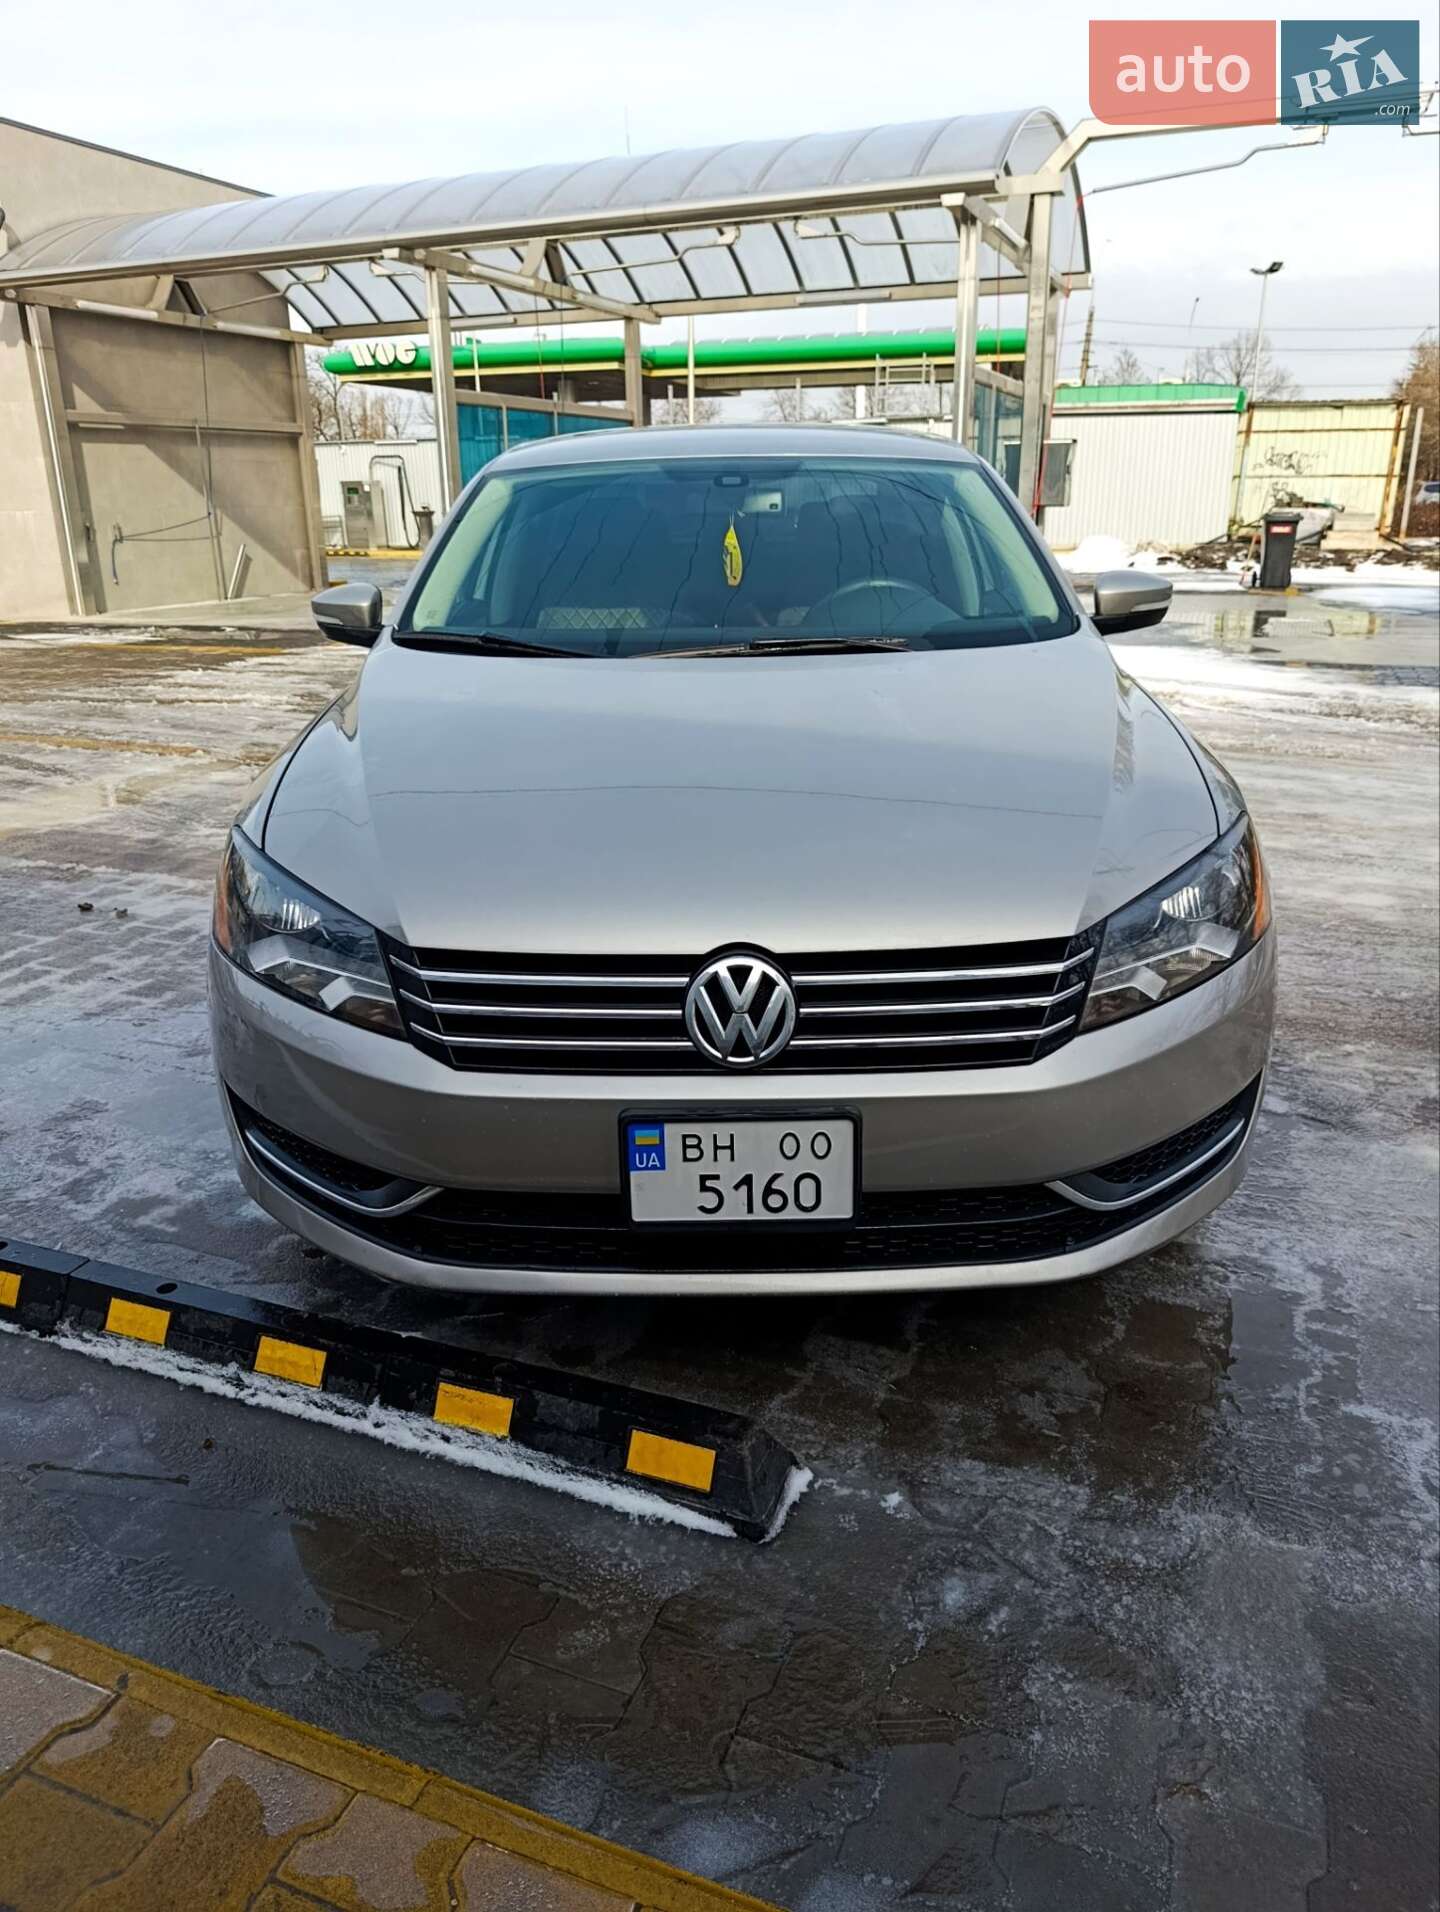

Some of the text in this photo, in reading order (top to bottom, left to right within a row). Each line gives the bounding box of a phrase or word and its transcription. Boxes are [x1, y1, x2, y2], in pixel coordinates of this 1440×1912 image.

[351, 341, 417, 367] WOG
[634, 1152, 660, 1168] UA
[681, 1131, 832, 1162] BH 00
[697, 1172, 822, 1214] 5160
